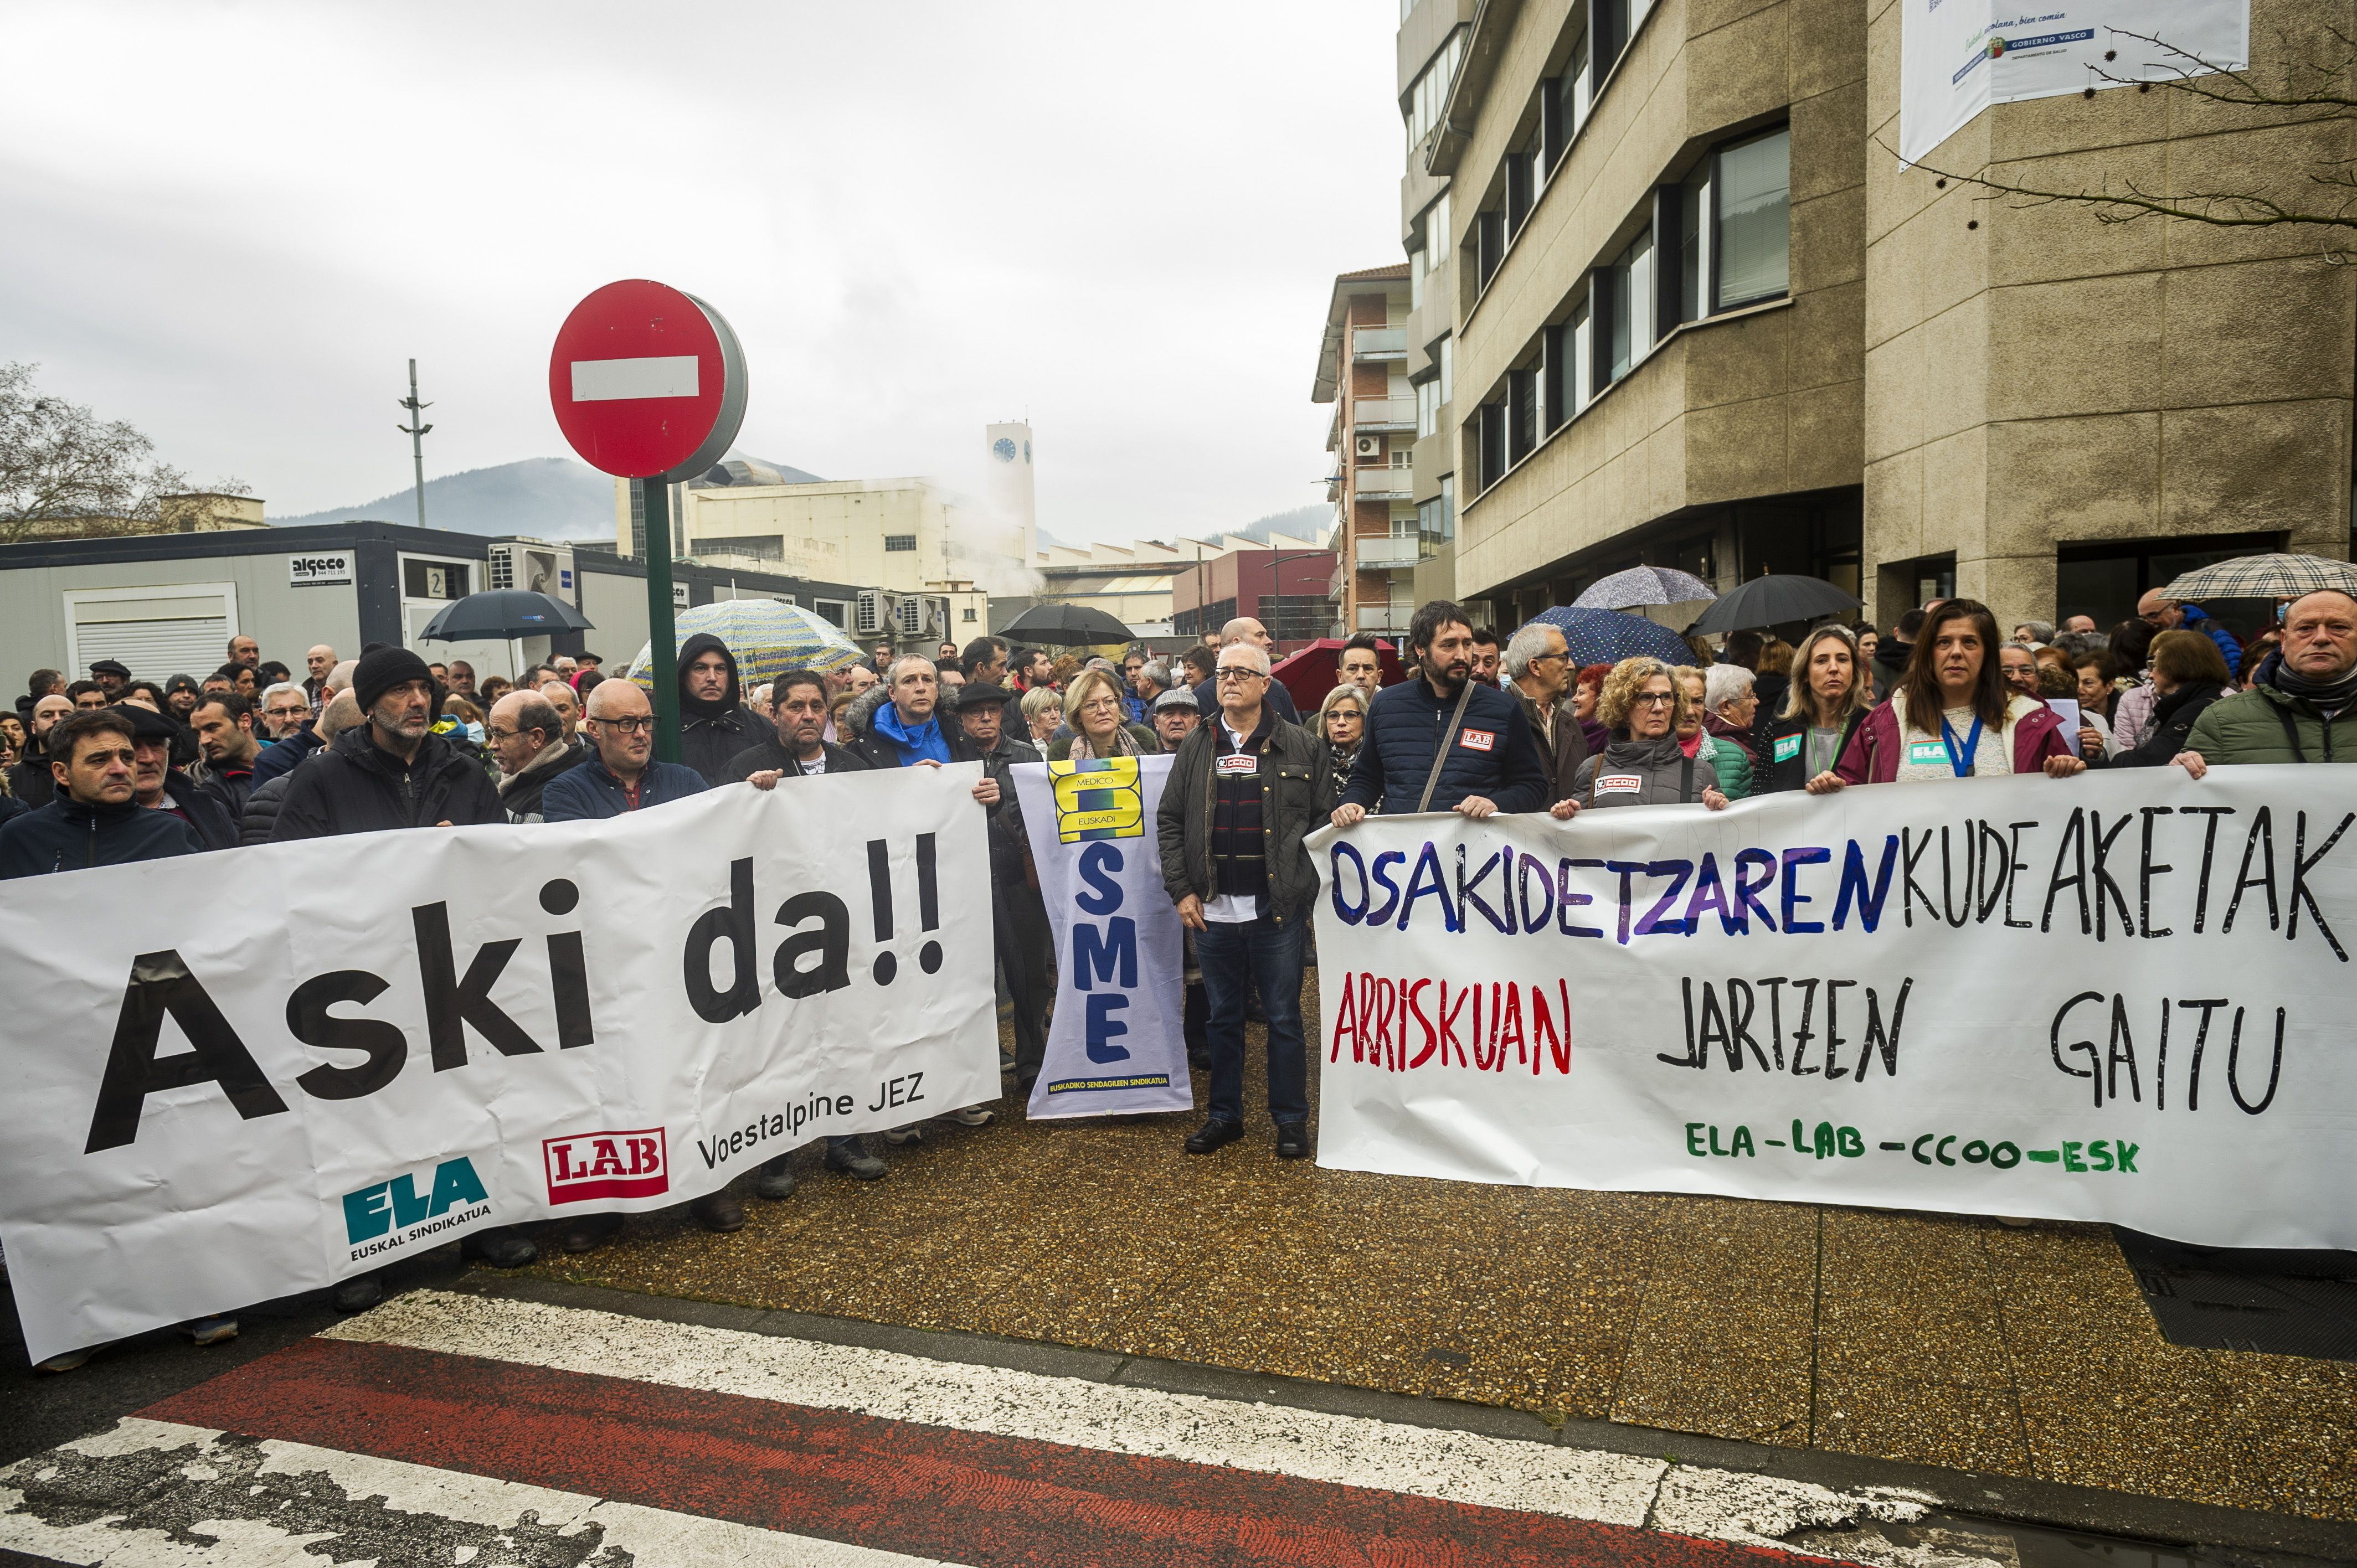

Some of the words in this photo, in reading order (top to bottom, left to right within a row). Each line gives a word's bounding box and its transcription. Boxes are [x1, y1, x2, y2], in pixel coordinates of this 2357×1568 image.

[2019, 16, 2036, 25] bien
[2039, 12, 2067, 22] común
[2012, 37, 2055, 48] GOBIERNO
[2059, 32, 2086, 41] VASCO
[292, 558, 345, 576] algeco
[432, 573, 440, 593] 2
[1465, 732, 1490, 745] LAB
[1776, 739, 1797, 754] ELA
[1912, 746, 1946, 757] ELA
[1228, 759, 1253, 767] CCOO
[1077, 777, 1114, 786] MEDICO
[1606, 778, 1637, 787] CCOO
[1078, 816, 1115, 825] EUSKADI
[1331, 834, 1899, 945] OSAKIDETZAREN
[1902, 806, 2356, 963] KUDEAKETAK
[84, 879, 594, 1154] Aski
[684, 832, 943, 1023] da!!
[1330, 972, 1571, 1075] ARRISKUAN
[1657, 977, 1913, 1083] JARTZEN
[2051, 991, 2286, 1116] GAITU
[1050, 1081, 1085, 1092] EUSKADIKO
[1087, 1079, 1129, 1088] SENDAGILEEN
[1130, 1077, 1167, 1086] SINDIKATUA
[697, 1091, 854, 1170] Voestalpine
[868, 1071, 924, 1112] JEZ
[552, 1138, 660, 1182] LAB
[342, 1156, 488, 1246] ELA
[351, 1235, 405, 1262] EUSKAL
[408, 1204, 491, 1241] SINDIKATUA
